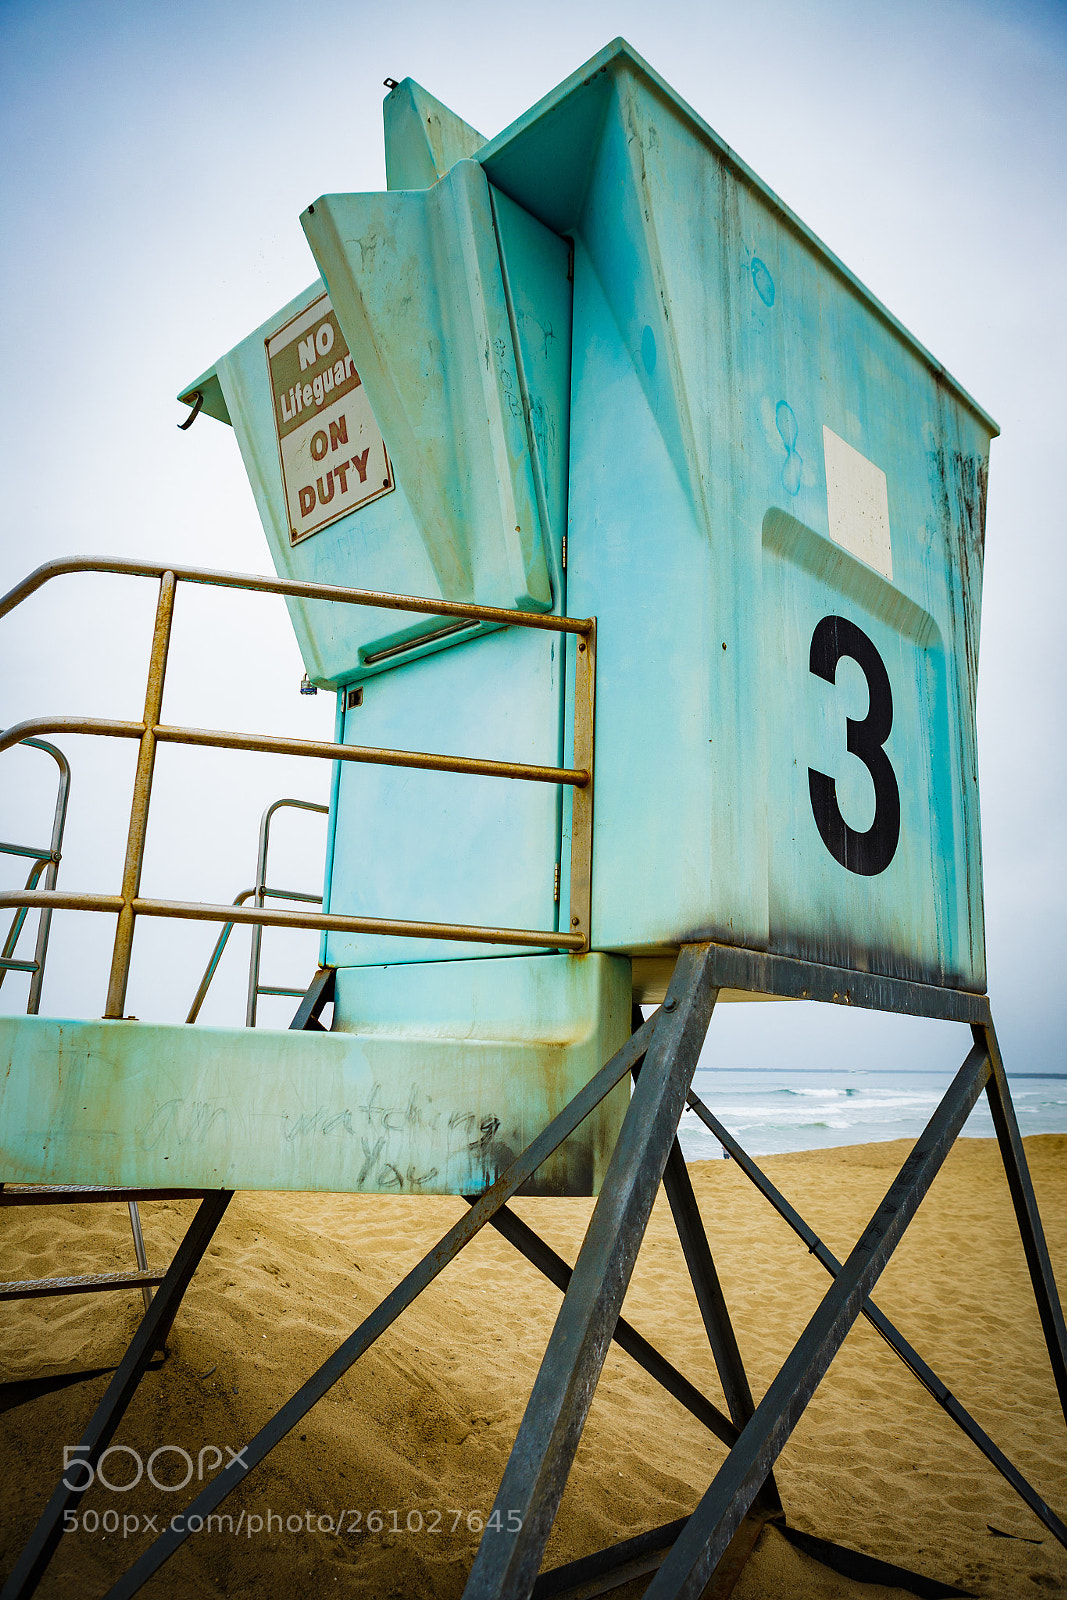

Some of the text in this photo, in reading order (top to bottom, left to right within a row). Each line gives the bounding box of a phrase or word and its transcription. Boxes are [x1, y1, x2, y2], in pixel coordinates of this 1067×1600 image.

[297, 322, 335, 372] NO
[280, 352, 354, 424] Lifeguar
[310, 414, 349, 463] ON
[298, 447, 370, 518] DUTY
[807, 614, 901, 877] 3
[281, 1082, 501, 1149] watching
